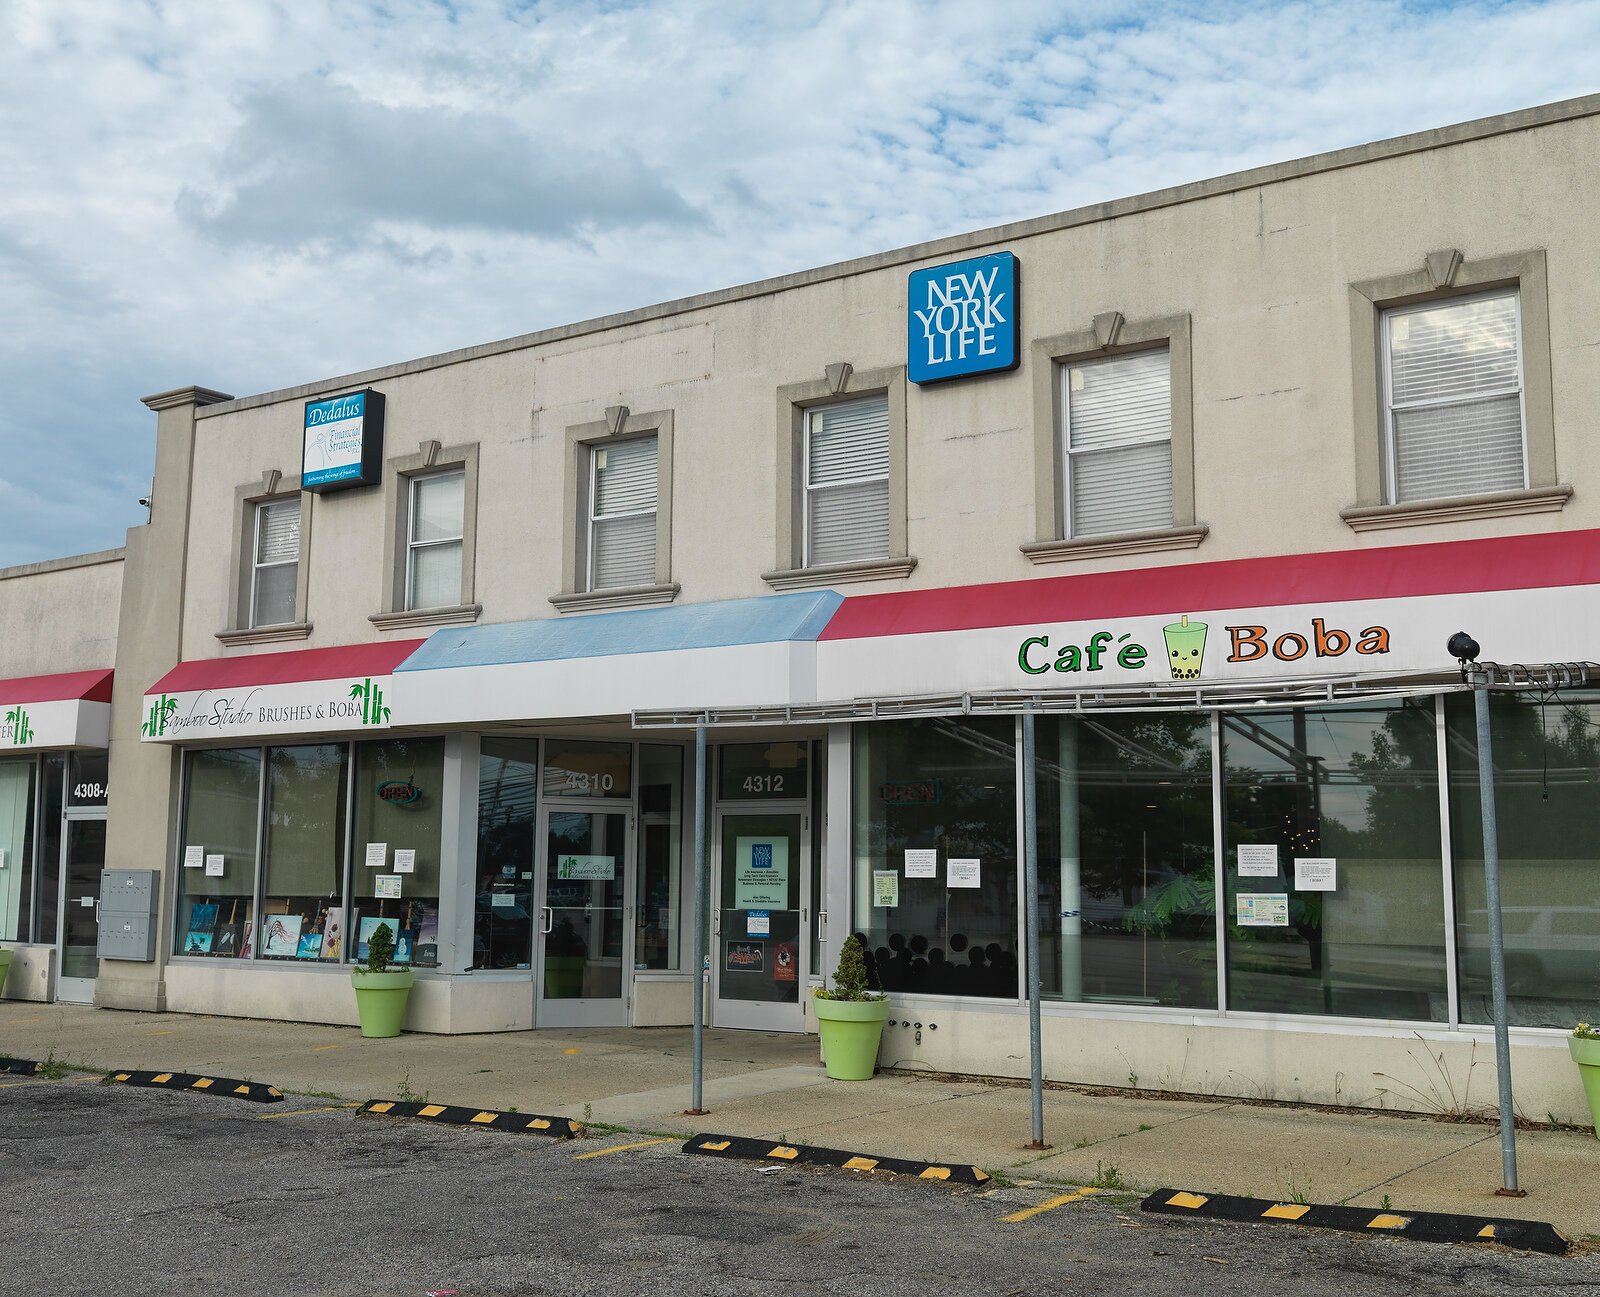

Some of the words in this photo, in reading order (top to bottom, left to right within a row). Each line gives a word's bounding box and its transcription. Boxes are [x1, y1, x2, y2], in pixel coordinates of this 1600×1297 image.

[926, 266, 999, 309] NEW
[913, 292, 1006, 337] YORK
[927, 326, 997, 365] LIFE
[310, 398, 360, 425] Dedalus
[1018, 631, 1148, 674] Café
[1225, 618, 1391, 663] Boba
[156, 690, 212, 734] Bamboo
[208, 688, 263, 729] Studio
[259, 706, 312, 722] BRUSHES
[315, 704, 325, 719] &
[329, 701, 362, 718] BOBA
[0, 725, 13, 738] ER
[379, 786, 414, 800] OPEN
[565, 773, 613, 791] 4310
[743, 774, 784, 792] 4312
